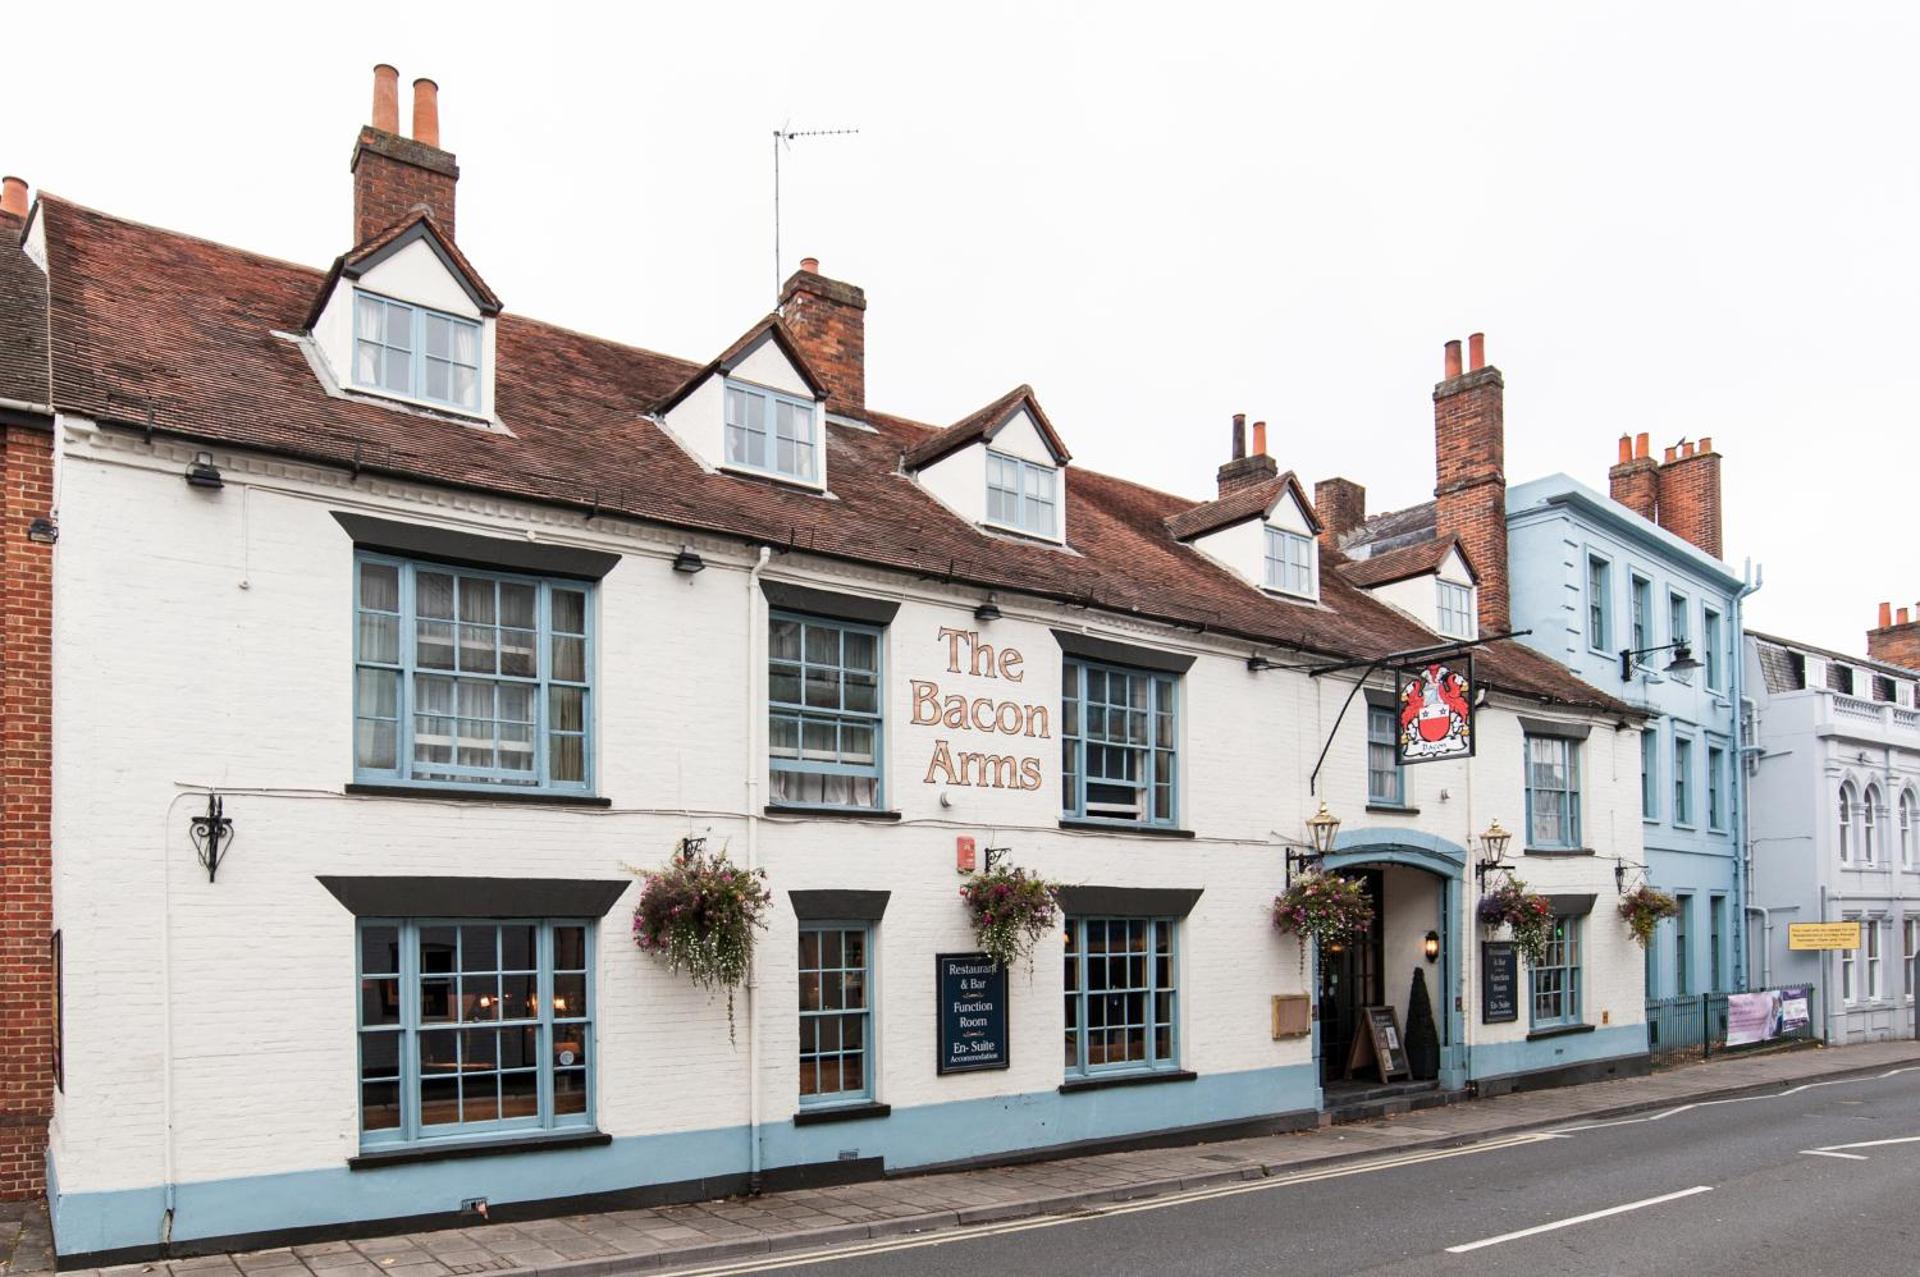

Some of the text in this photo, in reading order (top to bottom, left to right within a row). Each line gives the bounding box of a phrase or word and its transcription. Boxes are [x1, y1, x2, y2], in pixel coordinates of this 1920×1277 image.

[937, 626, 1025, 683] The
[909, 679, 1051, 739] Bacon
[923, 739, 1042, 791] Arms
[960, 978, 986, 989] & Bar
[953, 1002, 993, 1013] Function
[959, 1017, 988, 1028] Room
[971, 1040, 995, 1052] Suite
